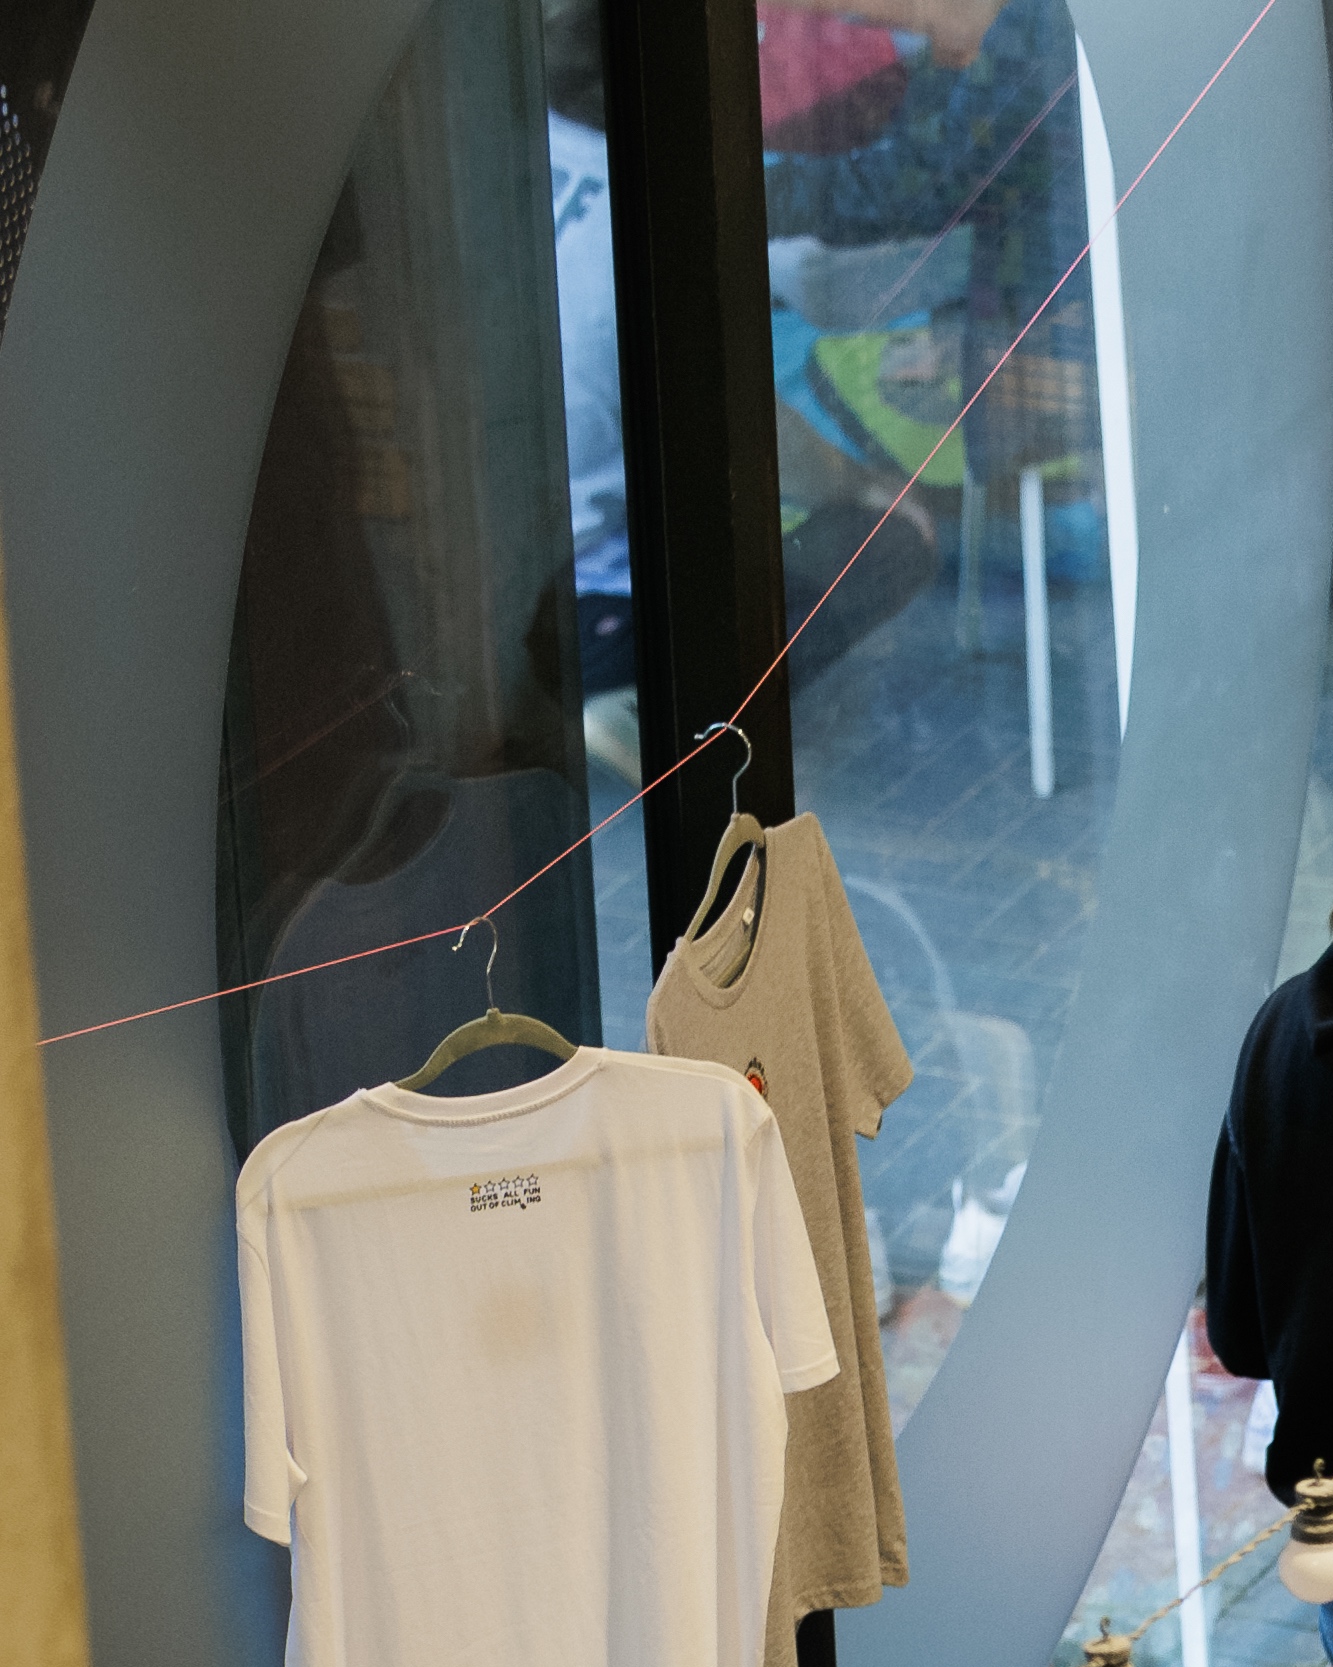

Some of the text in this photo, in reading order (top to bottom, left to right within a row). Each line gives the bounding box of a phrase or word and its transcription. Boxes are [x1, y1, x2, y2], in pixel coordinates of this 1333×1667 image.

[504, 1190, 519, 1198] ALL
[524, 1187, 540, 1196] FUN
[470, 1203, 487, 1212] OUT
